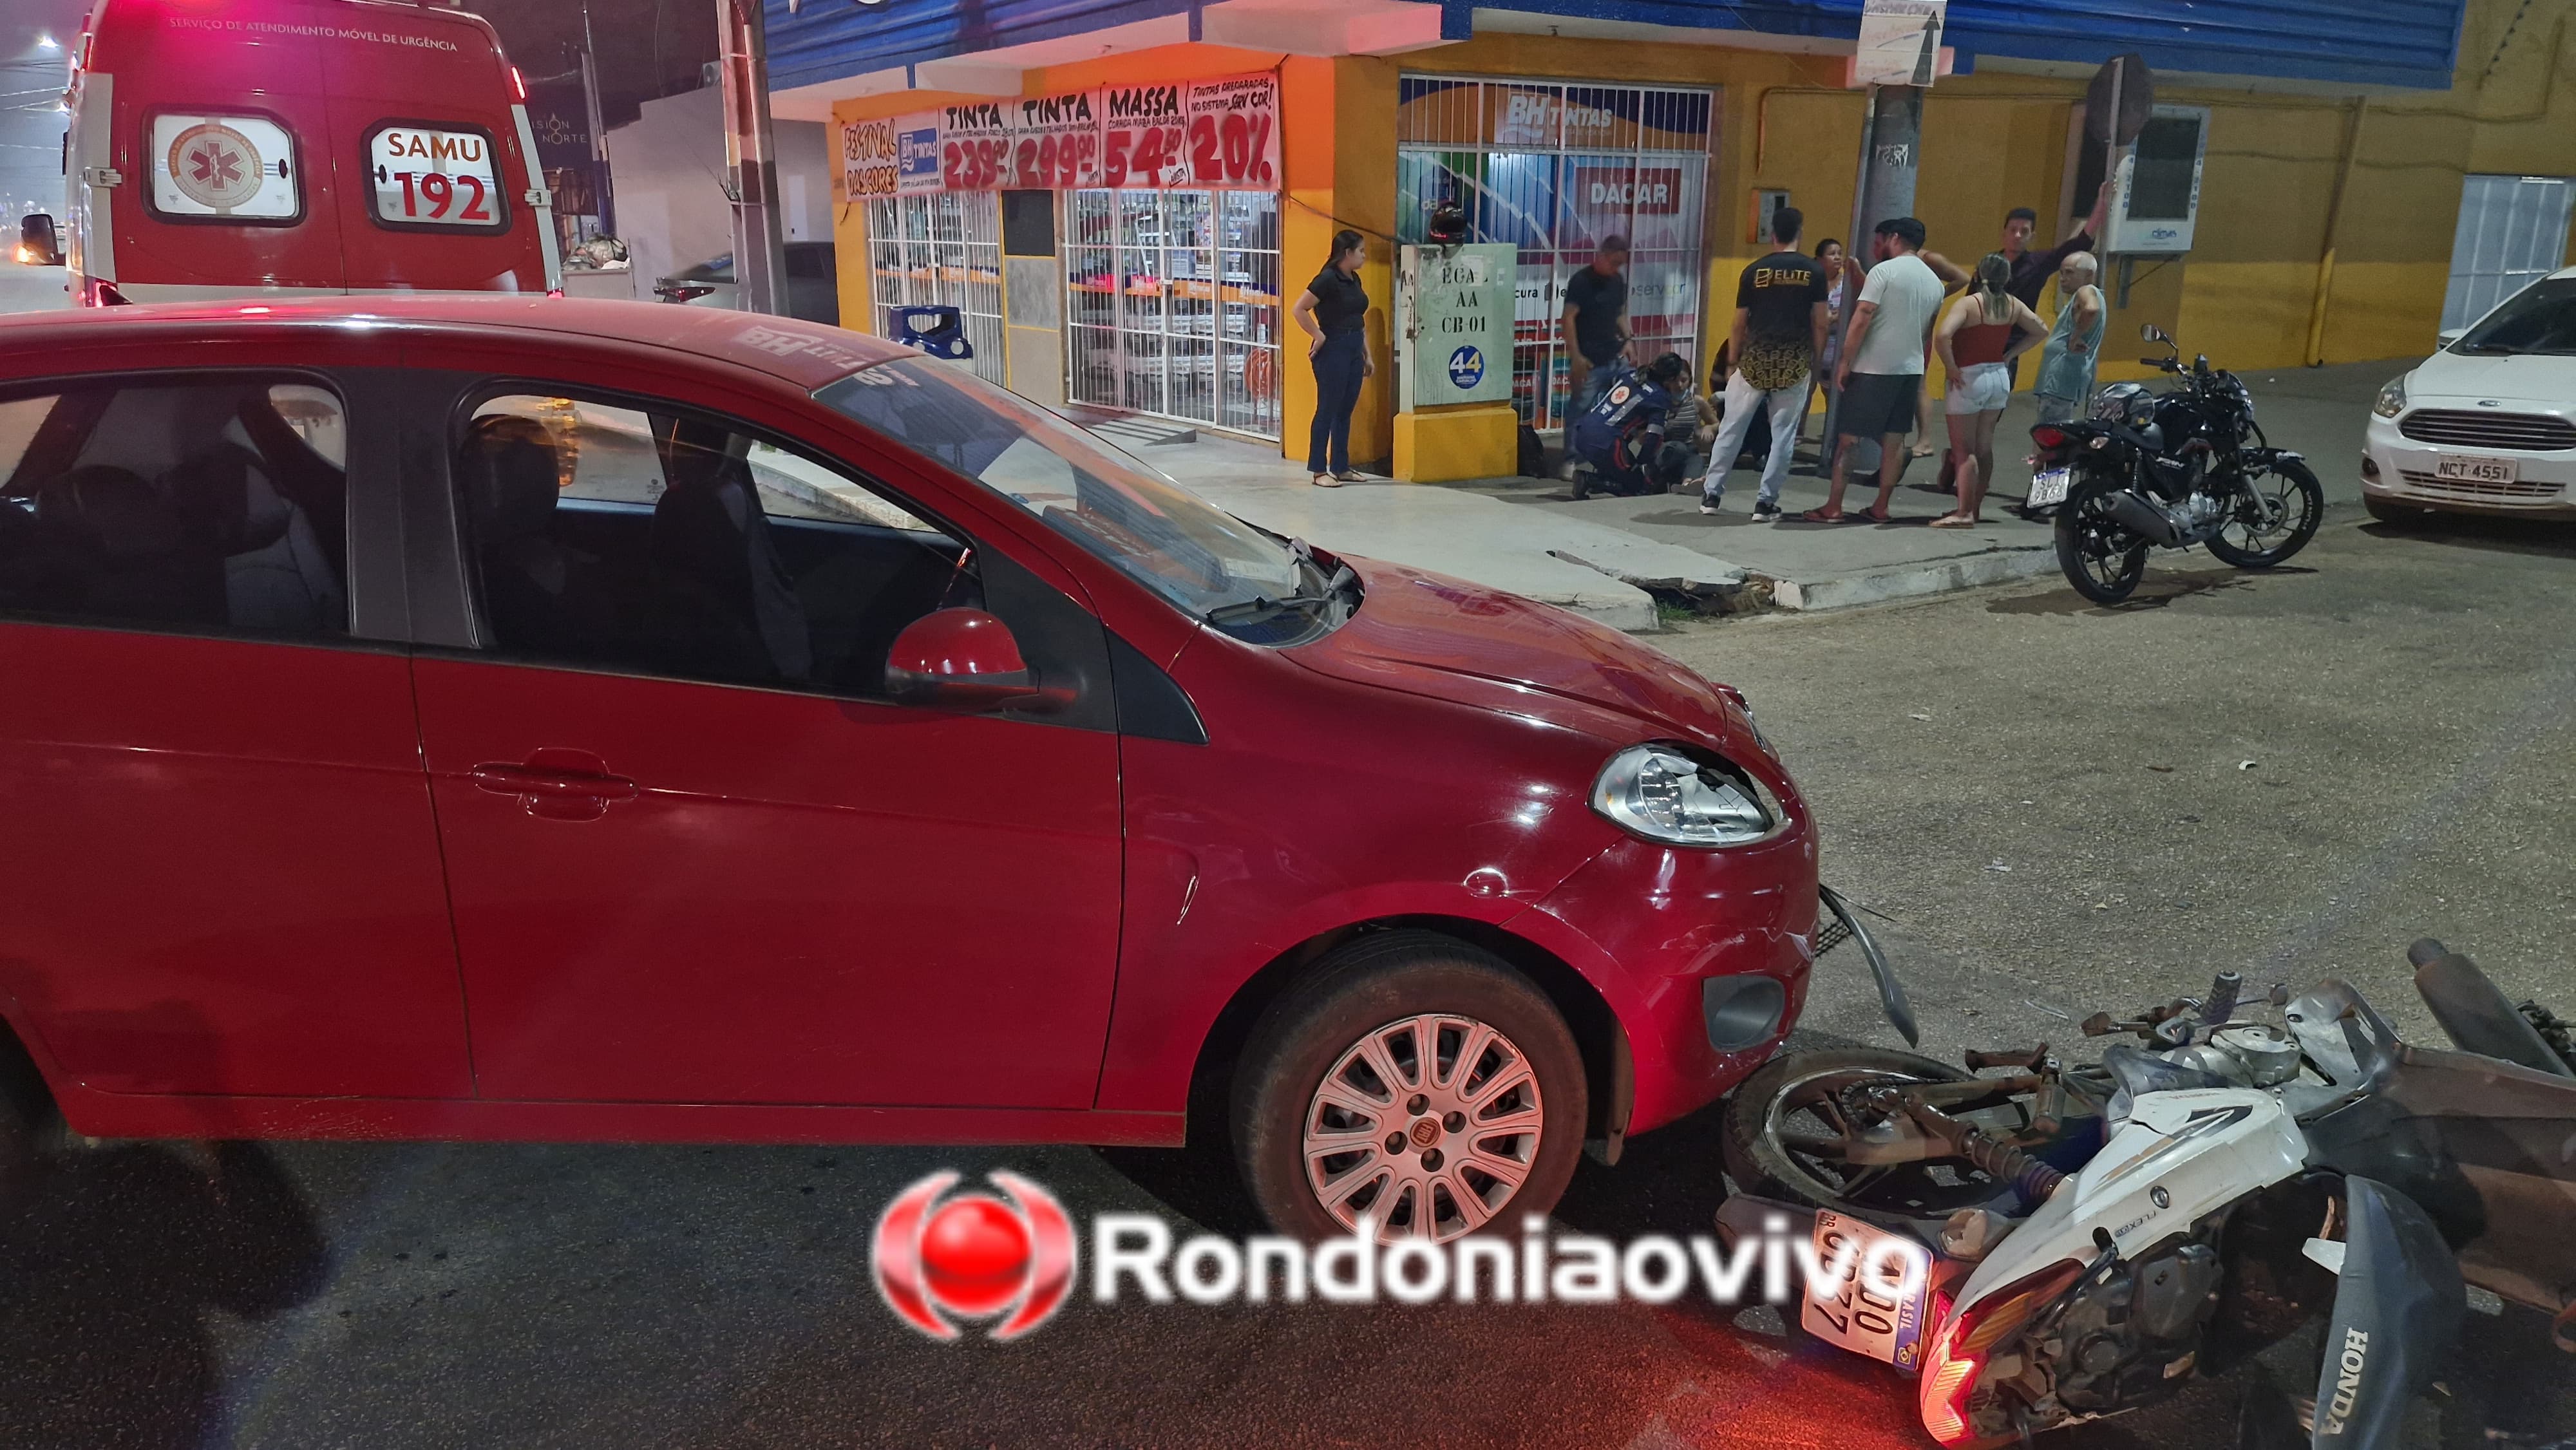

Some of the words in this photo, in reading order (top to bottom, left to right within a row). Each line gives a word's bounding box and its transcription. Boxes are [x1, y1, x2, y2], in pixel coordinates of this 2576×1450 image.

[169, 18, 222, 30] SERVIÇO
[226, 21, 242, 30] DE
[247, 23, 334, 37] ATENDIMENTO
[339, 28, 380, 42] MÓVEL
[383, 33, 397, 44] DE
[400, 36, 457, 52] URGÊNCIA
[1110, 86, 1179, 117] MASSA
[1191, 102, 1201, 112] NO
[1202, 99, 1229, 111] SISTEMA
[1193, 84, 1220, 98] TINTAS
[946, 103, 1003, 130] TINTA
[1023, 93, 1092, 126] TINTA
[1508, 96, 1549, 125] BH
[388, 133, 481, 162] SAMU
[542, 133, 587, 145] NORTE
[845, 118, 897, 162] FESTIVAL
[914, 142, 937, 159] TINTAS
[1189, 113, 1272, 182] 20%
[847, 169, 867, 196] DAS
[865, 165, 898, 194] CORES
[1591, 183, 1668, 204] DACAR
[394, 172, 489, 220] 192
[1455, 291, 1479, 308] AA
[1450, 351, 1482, 374] 44
[2438, 462, 2468, 477] NCT
[2470, 466, 2508, 480] 4551
[2318, 1326, 2369, 1435] HONDA
